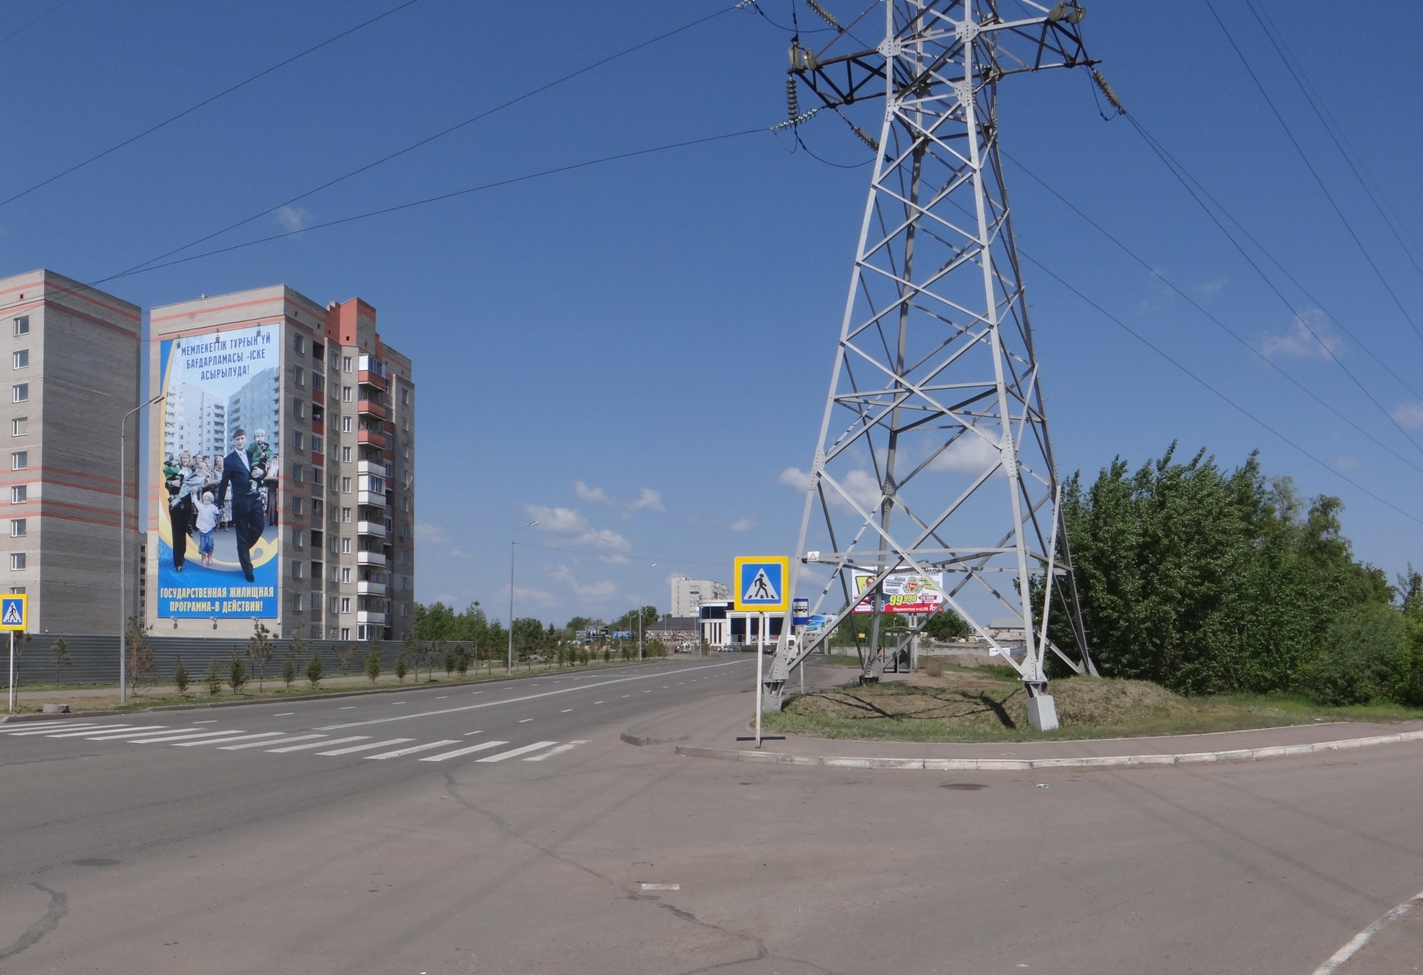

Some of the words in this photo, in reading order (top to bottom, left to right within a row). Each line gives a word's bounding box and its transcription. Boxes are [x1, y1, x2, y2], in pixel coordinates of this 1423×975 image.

[230, 337, 258, 349] ТҰРҒЫН
[261, 332, 271, 344] ҮЙ
[186, 353, 243, 369] БАҒДАРЛАМАСЫ
[200, 365, 250, 381] АСЫРЫЛУДА!
[160, 587, 227, 600] ГОСУДАРСТВЕННАЯ
[229, 586, 274, 599] ЖИЛИЩНАЯ
[222, 600, 263, 614] ДЕЙСТВИИ!
